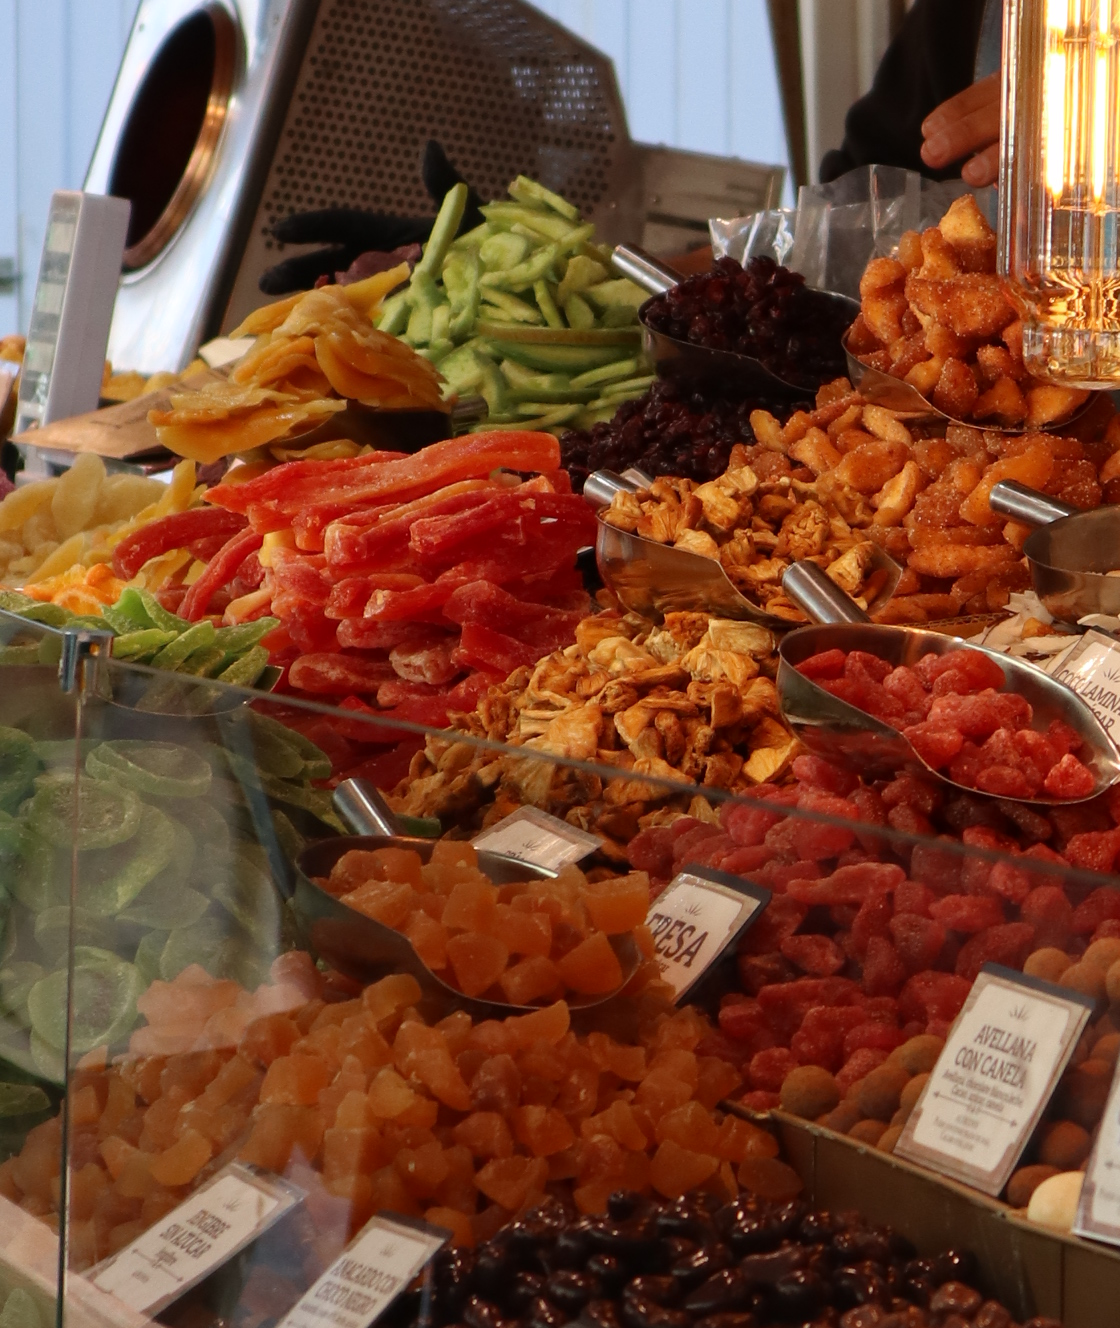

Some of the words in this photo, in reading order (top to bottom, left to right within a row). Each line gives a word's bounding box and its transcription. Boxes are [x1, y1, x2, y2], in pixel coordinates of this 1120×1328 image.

[647, 913, 708, 968] FRESA
[973, 1023, 1039, 1062] AVELLANA
[953, 1045, 984, 1072] CON
[977, 1054, 1028, 1089] CANELA
[158, 1222, 185, 1241] SIN
[186, 1208, 233, 1239] JENGIBRE
[169, 1226, 217, 1260] AZÚCAR
[312, 1279, 352, 1306] CHOCO
